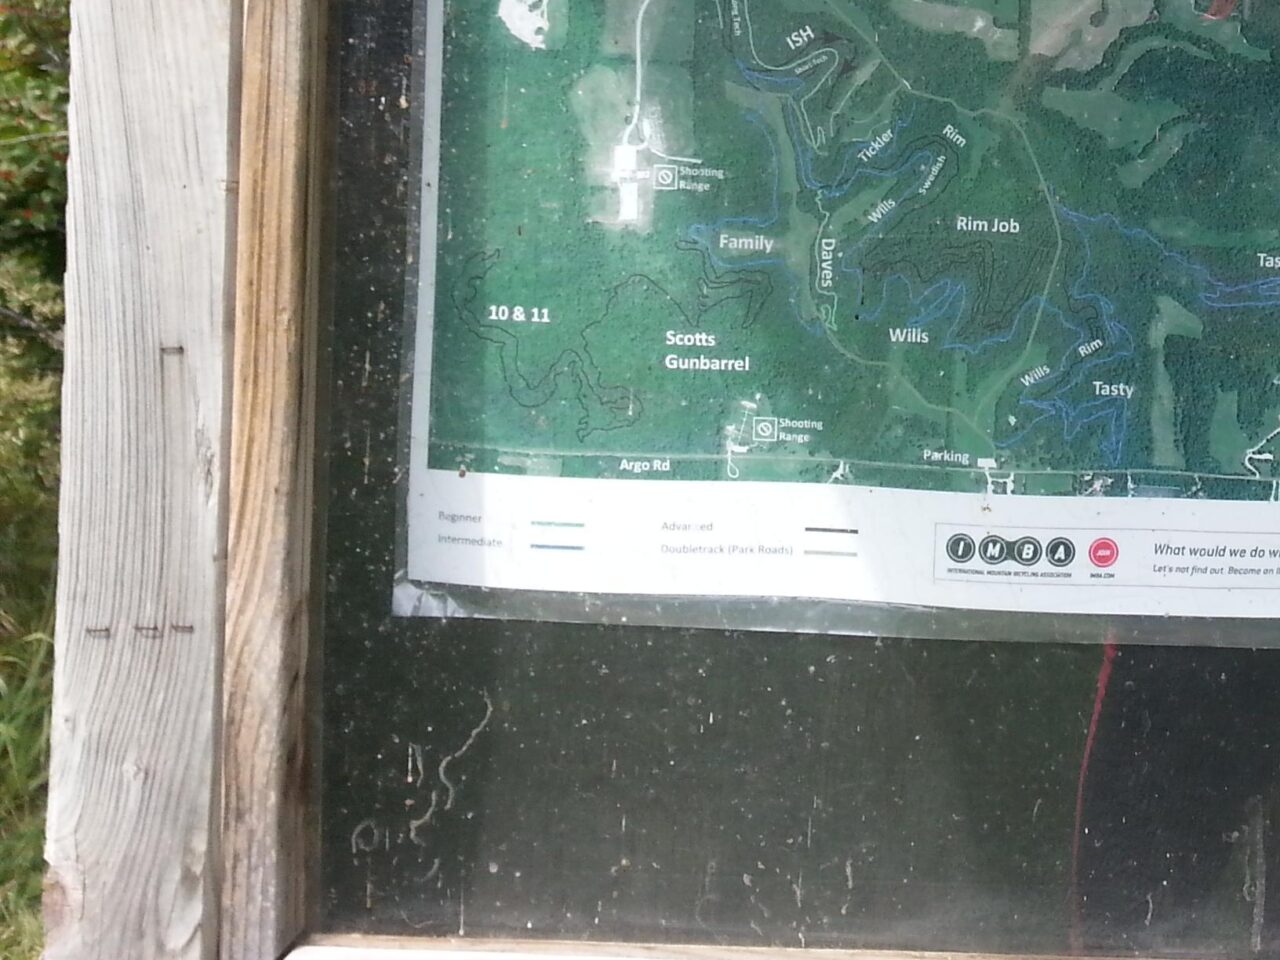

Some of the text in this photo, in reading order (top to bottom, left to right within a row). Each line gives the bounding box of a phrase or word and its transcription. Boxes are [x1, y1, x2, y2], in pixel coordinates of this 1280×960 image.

[785, 25, 815, 50] ISH
[941, 124, 967, 149] Rim
[856, 127, 896, 164] Tickler
[680, 166, 724, 179] Shooting
[917, 154, 947, 196] Swedish
[679, 180, 710, 192] Range
[867, 196, 897, 225] Wills
[956, 216, 1021, 235] Rim Job
[718, 234, 775, 254] Family
[820, 238, 837, 289] Daves
[488, 304, 551, 322] 10 & 11
[665, 330, 716, 346] Scotts
[888, 327, 930, 344] Wills
[1077, 338, 1103, 358] Rim
[664, 354, 750, 371] Gunbarrel
[1019, 363, 1051, 388] Wills
[1092, 380, 1135, 400] Tasty
[778, 417, 823, 431] Shooting
[778, 431, 811, 443] Range
[922, 449, 970, 465] Parking
[619, 458, 671, 474] Argo Rd
[438, 510, 482, 524] Beginner
[661, 521, 713, 532] Advaned
[437, 533, 503, 547] Intermediate
[660, 543, 794, 556] Doubletrack (Park Roads)
[1153, 543, 1186, 557] What
[1189, 544, 1228, 559] would
[1229, 547, 1247, 558] we
[1249, 546, 1266, 559] do
[1152, 564, 1174, 574] Let's
[1175, 565, 1189, 574] not
[1190, 565, 1208, 576] find
[1227, 566, 1262, 576] Become
[1262, 567, 1274, 576] an
